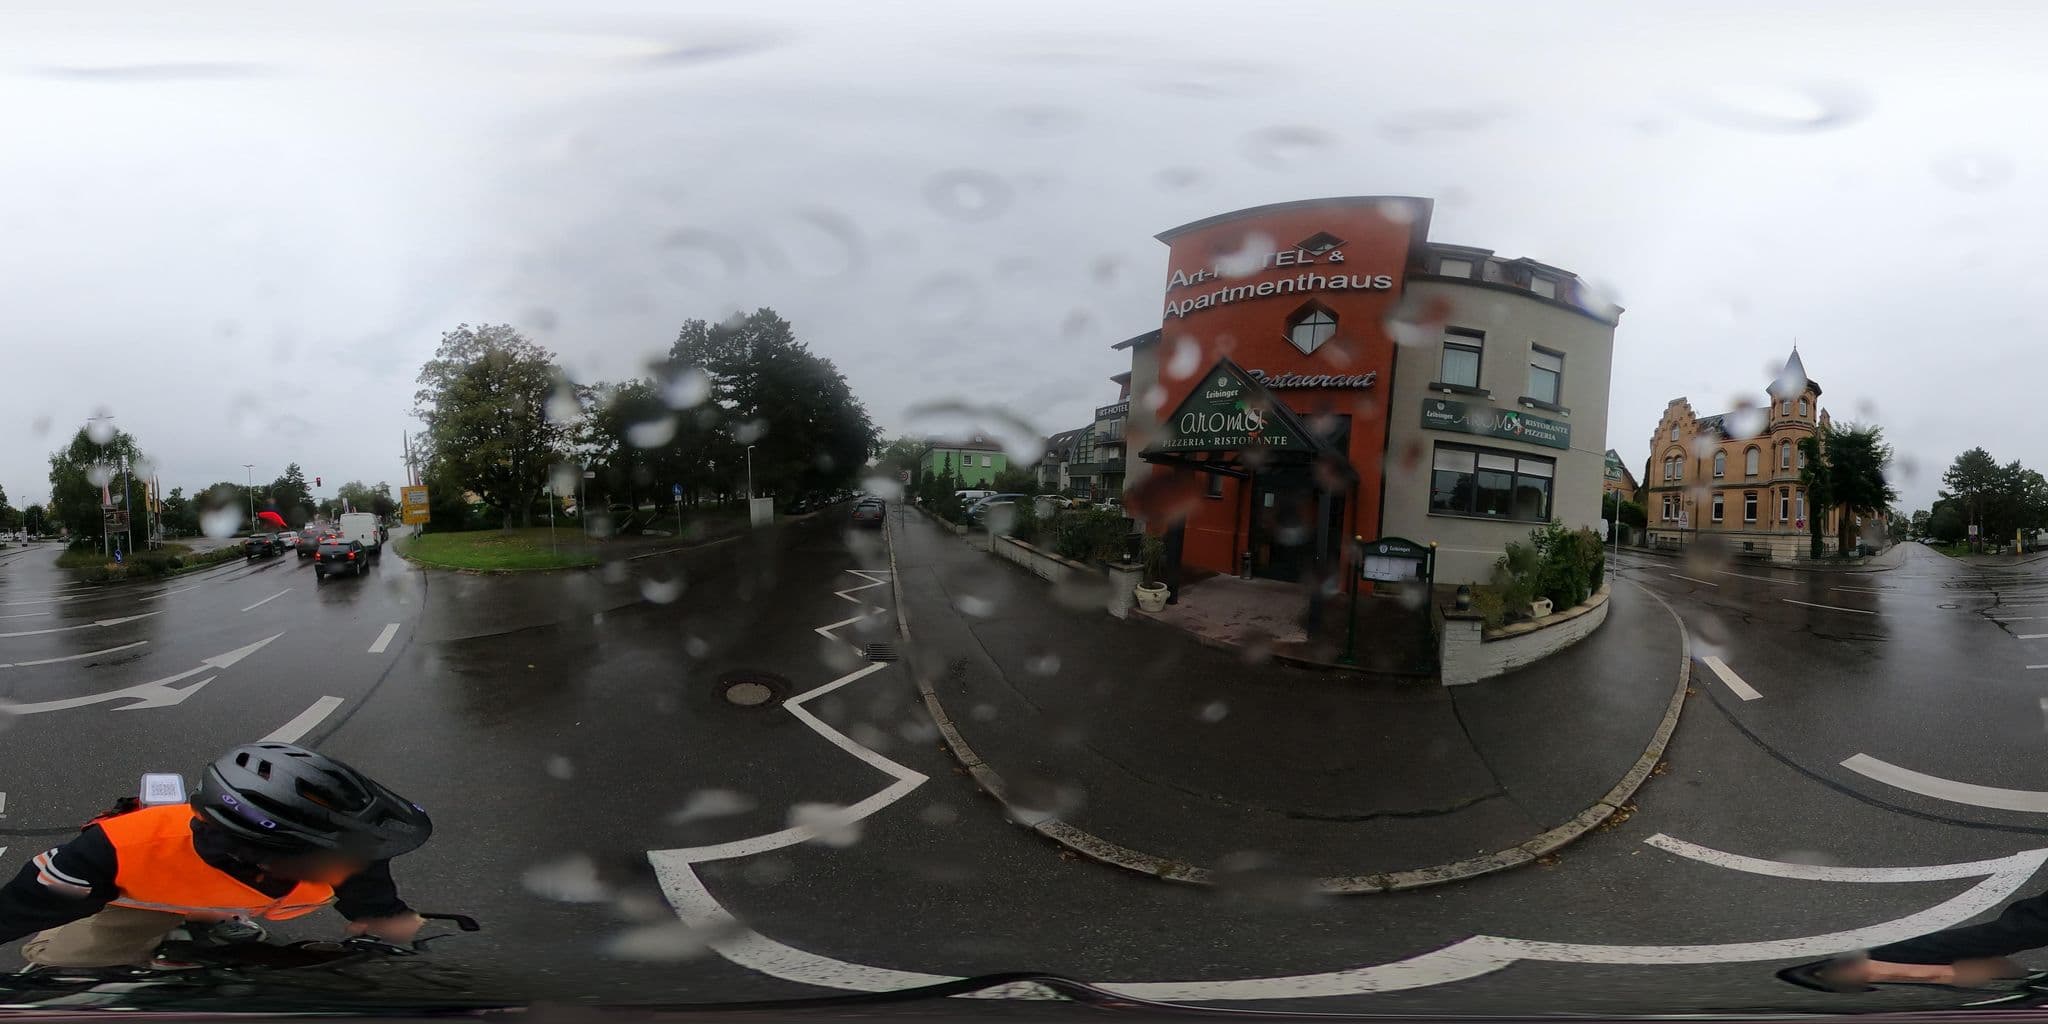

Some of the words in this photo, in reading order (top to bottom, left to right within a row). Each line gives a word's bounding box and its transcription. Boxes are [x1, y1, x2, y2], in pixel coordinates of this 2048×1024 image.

[1329, 250, 1345, 262] &
[1165, 272, 1393, 318] Apartmenthaus
[1206, 389, 1239, 399] Leibinger
[1525, 419, 1568, 435] RISTORANTE
[1525, 428, 1556, 440] PIZZERIA
[1162, 438, 1205, 447] PIZZERIA
[1214, 436, 1288, 446] RISTORANTE
